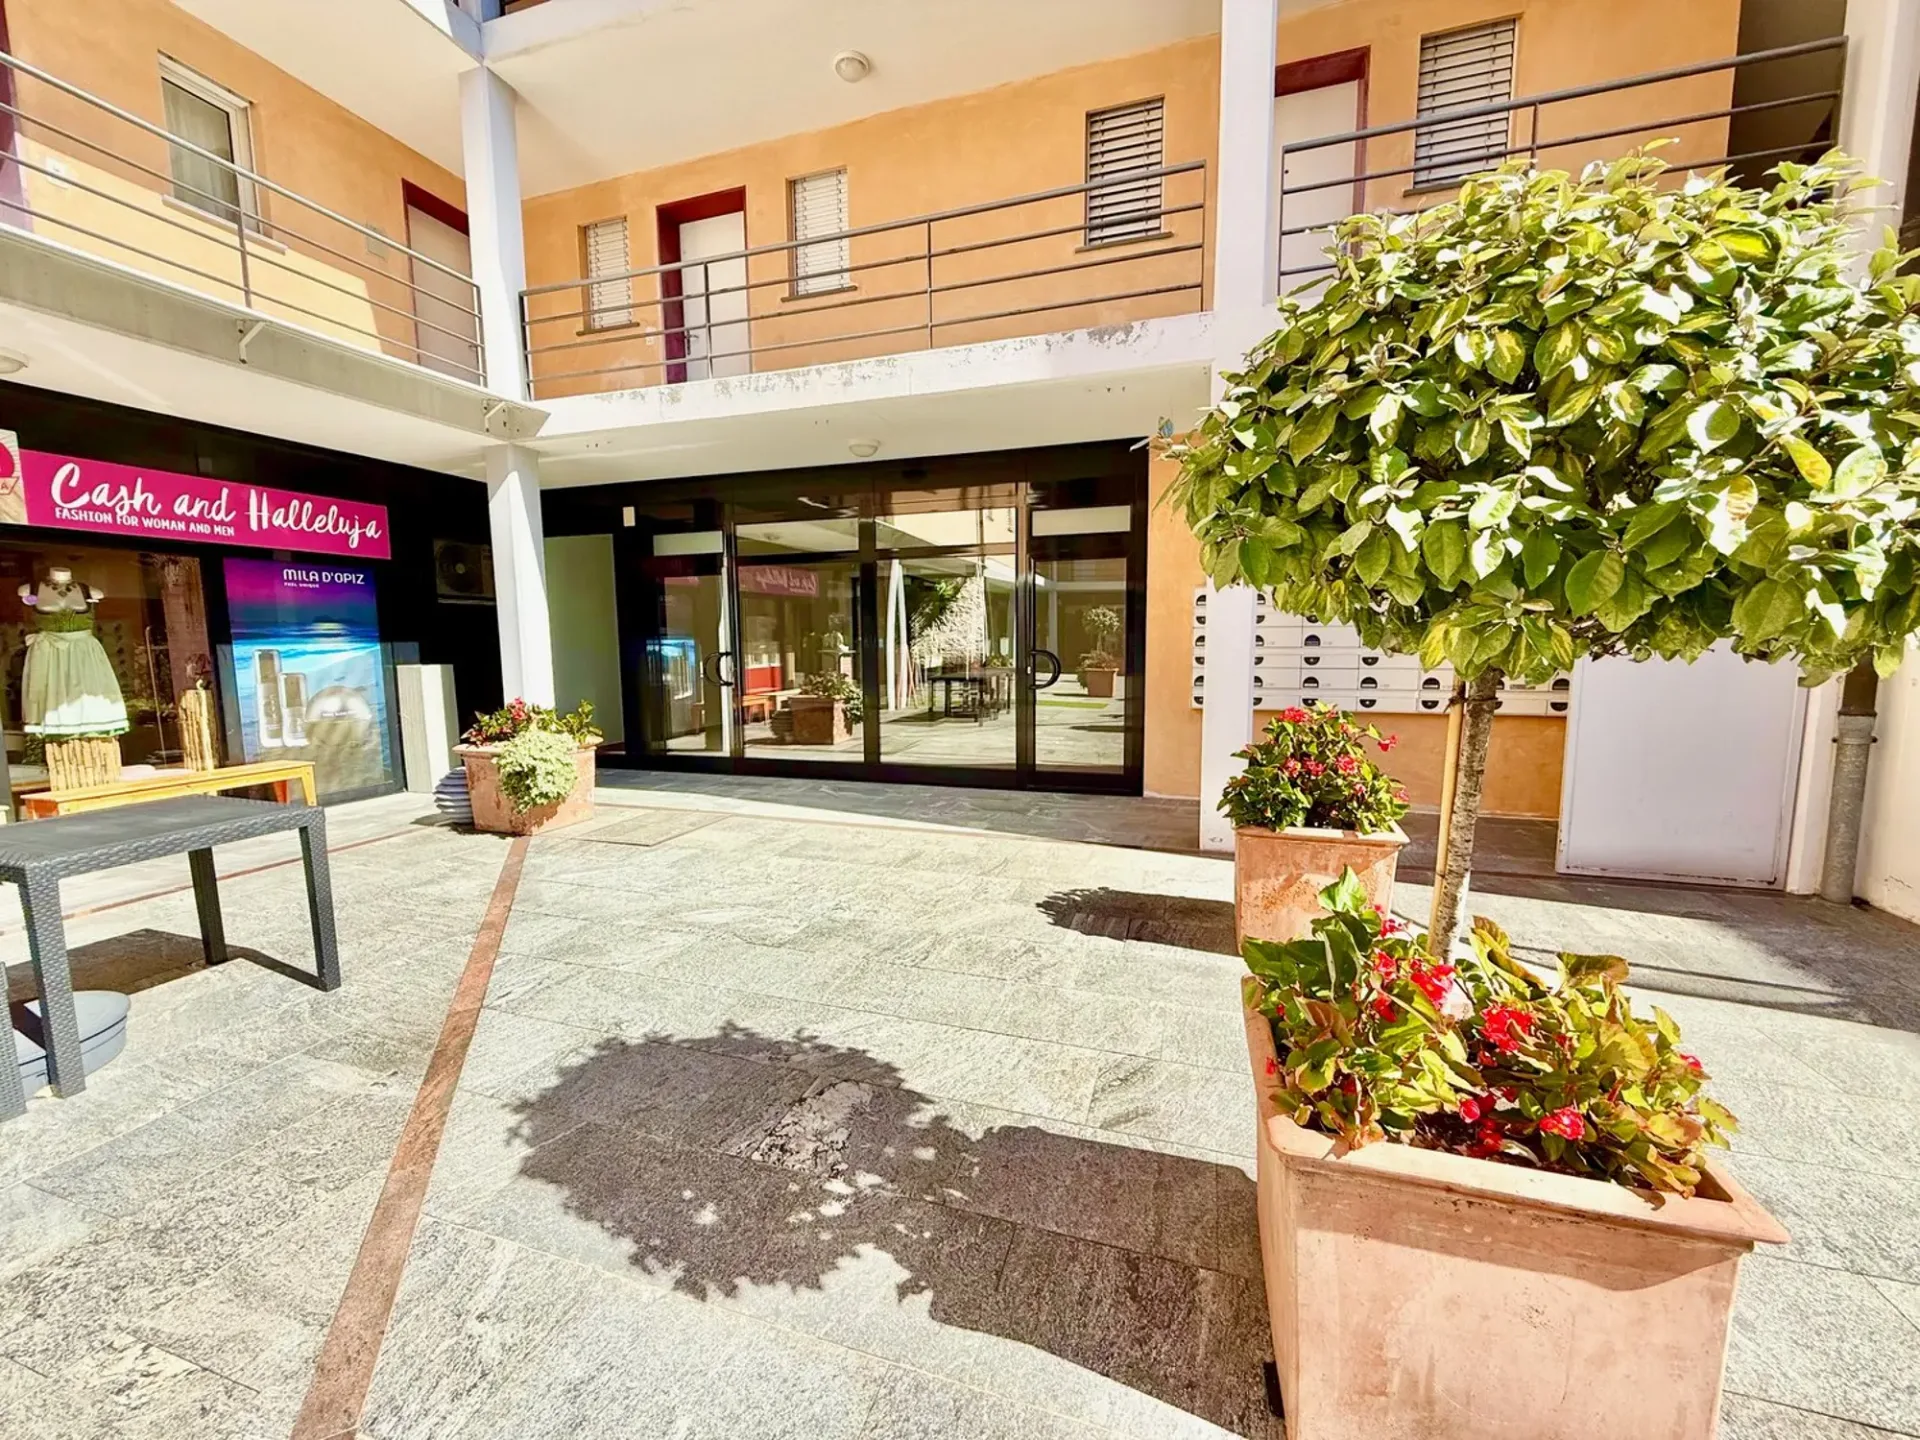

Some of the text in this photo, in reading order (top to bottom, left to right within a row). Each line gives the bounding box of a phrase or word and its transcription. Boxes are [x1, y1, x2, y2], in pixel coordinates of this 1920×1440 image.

[51, 462, 382, 549] Cash and Halleluja
[55, 507, 235, 537] FASHION FOR WOMAN AND MEN
[283, 568, 365, 585] MILA D'OPIZ
